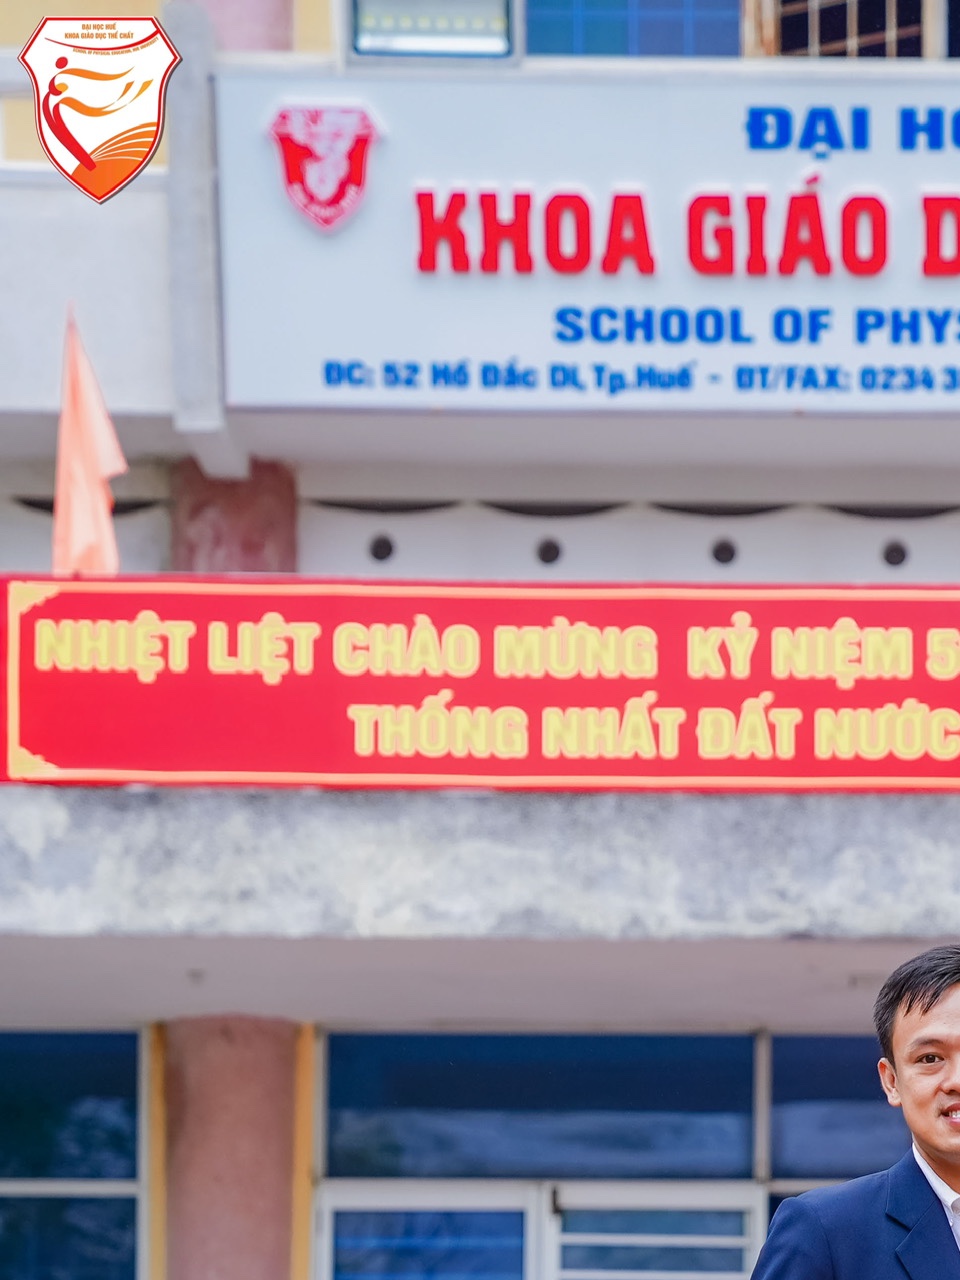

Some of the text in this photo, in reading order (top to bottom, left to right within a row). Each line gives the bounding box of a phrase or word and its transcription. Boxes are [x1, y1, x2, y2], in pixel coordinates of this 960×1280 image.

[745, 106, 870, 160] ĐẠI
[416, 191, 655, 275] KHOA
[688, 173, 888, 276] GIÁO
[555, 306, 753, 344] SCHOOL
[772, 306, 833, 344] OF
[383, 361, 421, 387] 52
[858, 366, 936, 392] 0234
[33, 610, 197, 683] NHIỆT
[207, 612, 321, 685] LIỆT
[333, 613, 481, 677] CHÀO
[493, 615, 659, 679] MỪNG
[687, 611, 758, 679] KỶ
[771, 617, 914, 689] NIỆM
[347, 688, 529, 759] THỐNG
[541, 690, 687, 759] NHẤT
[696, 691, 803, 760] ĐẤT
